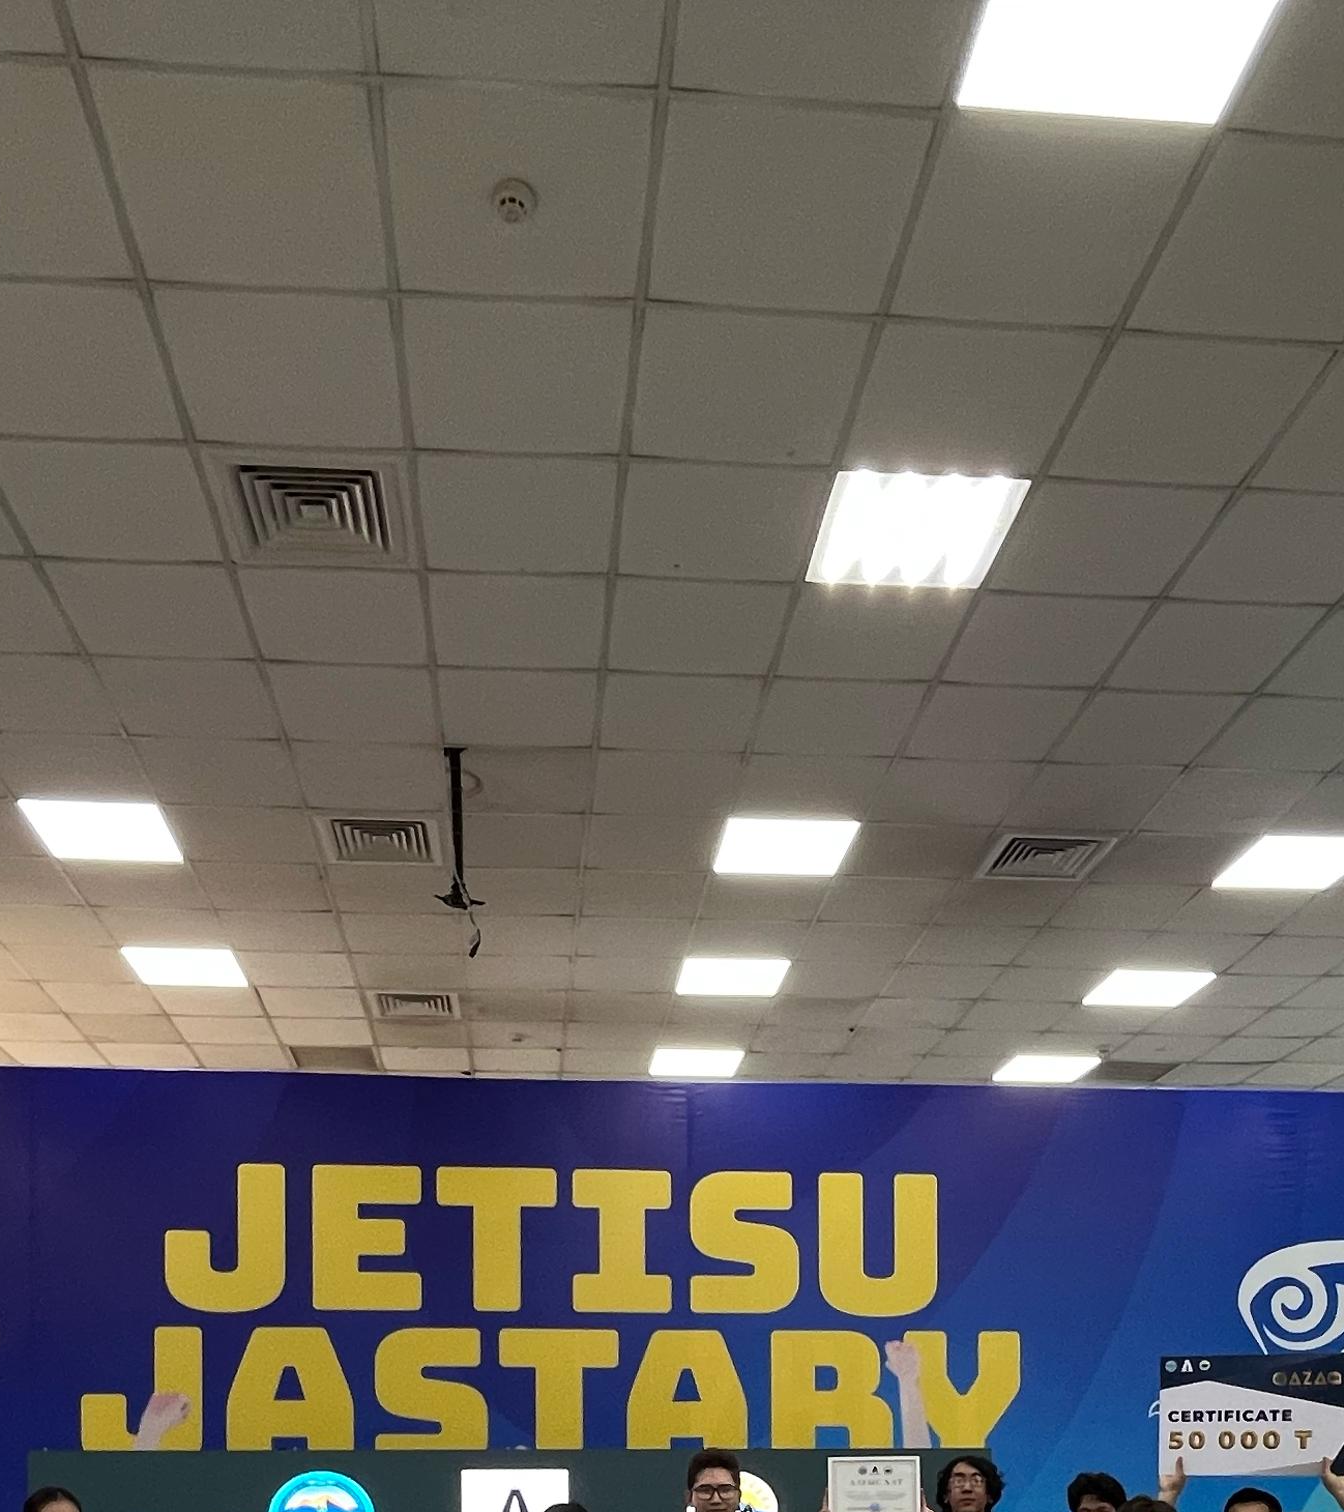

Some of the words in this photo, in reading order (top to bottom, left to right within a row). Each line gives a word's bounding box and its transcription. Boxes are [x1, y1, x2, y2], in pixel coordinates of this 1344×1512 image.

[163, 1162, 939, 1318] JETISU
[80, 1326, 1021, 1451] JASTARY
[1167, 1409, 1293, 1423] CERTIFICATE
[1168, 1430, 1206, 1450] 50
[1218, 1430, 1281, 1450] 000
